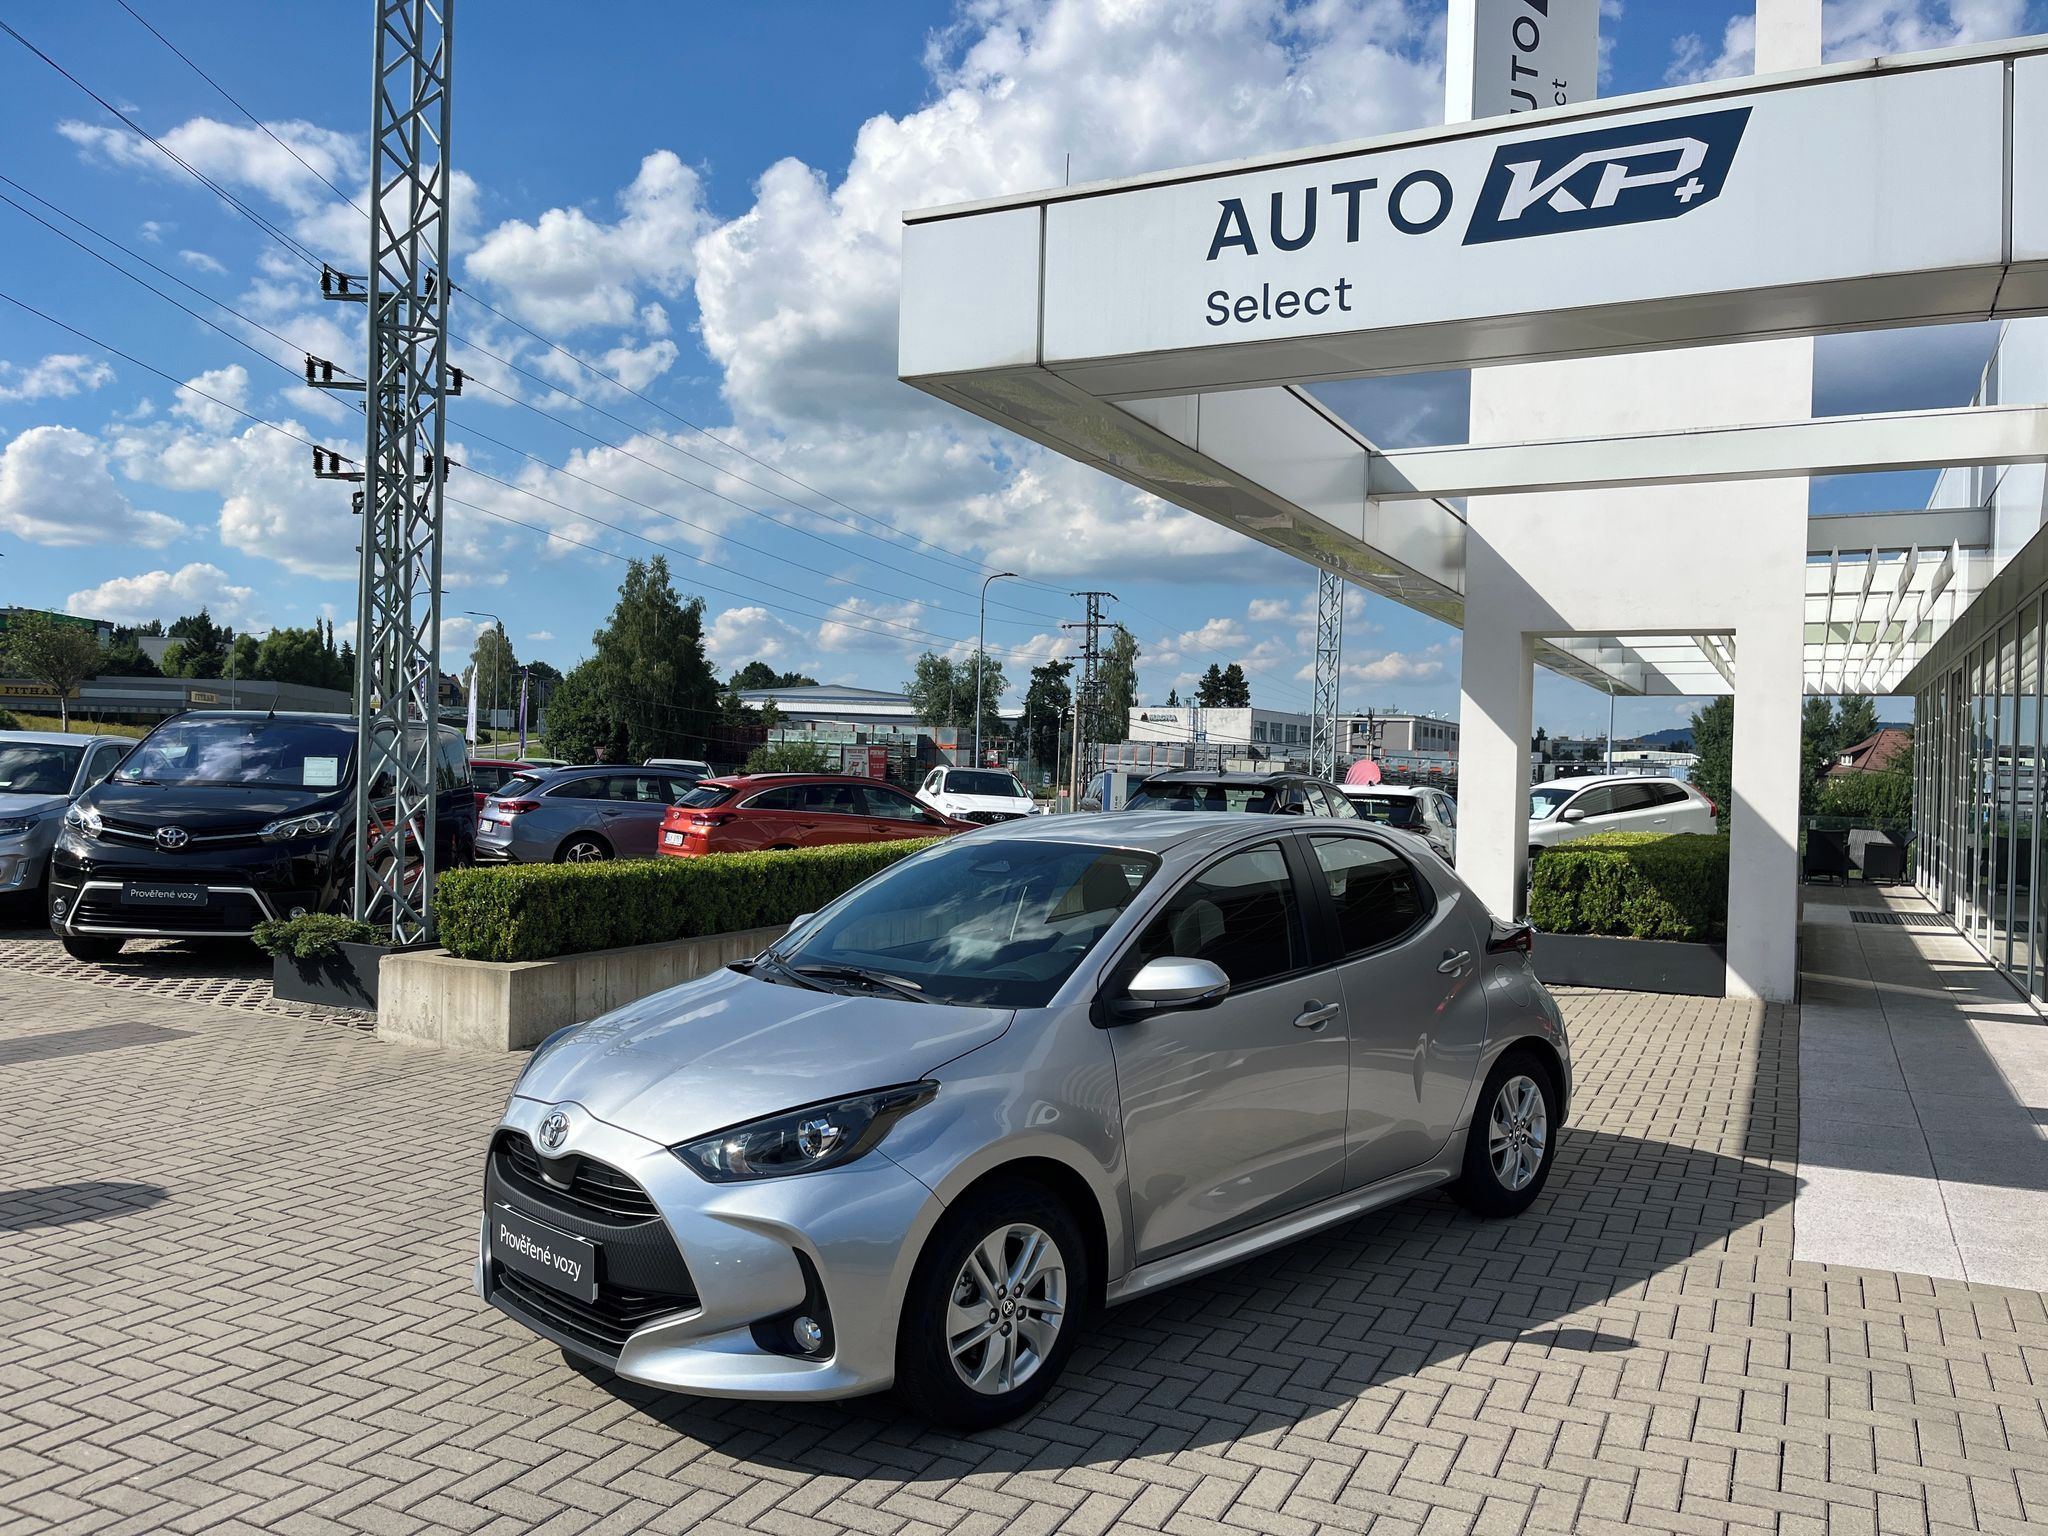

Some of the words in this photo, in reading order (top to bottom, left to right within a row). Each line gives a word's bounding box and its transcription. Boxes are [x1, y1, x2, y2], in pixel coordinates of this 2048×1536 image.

[1206, 169, 1454, 261] AUTO
[1205, 277, 1353, 326] Select
[130, 888, 176, 899] Prověřené
[177, 891, 198, 901] vozy
[500, 1223, 551, 1265] Prověřené
[553, 1253, 582, 1282] vozy
